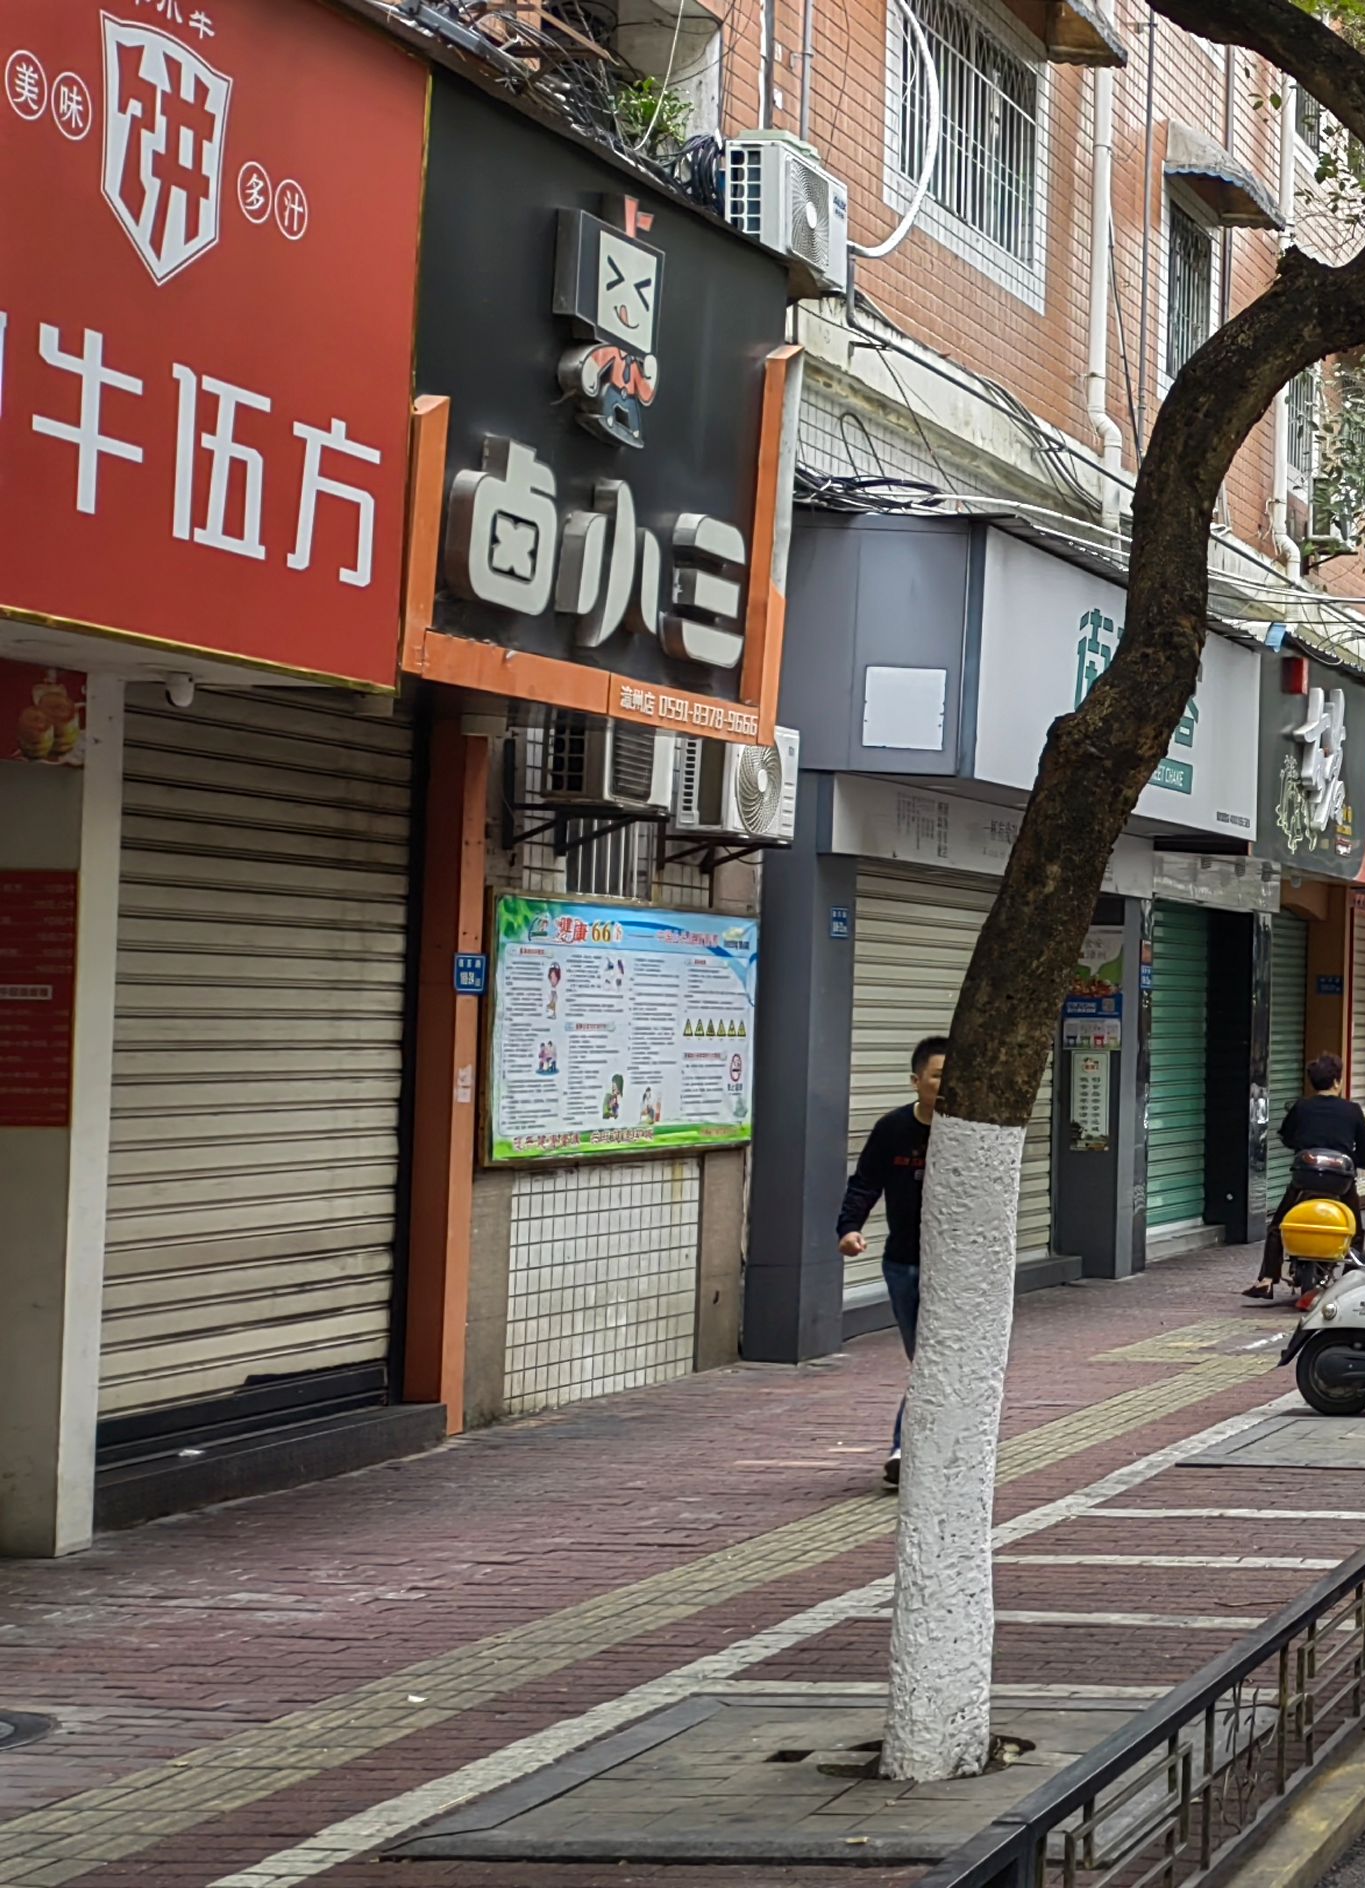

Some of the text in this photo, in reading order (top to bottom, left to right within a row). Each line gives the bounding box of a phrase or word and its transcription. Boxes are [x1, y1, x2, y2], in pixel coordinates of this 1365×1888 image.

[13, 60, 85, 130] 美味
[244, 172, 305, 232] 多汁
[0, 312, 381, 587] 牛伍方
[659, 695, 758, 736] 0591-8378-9666
